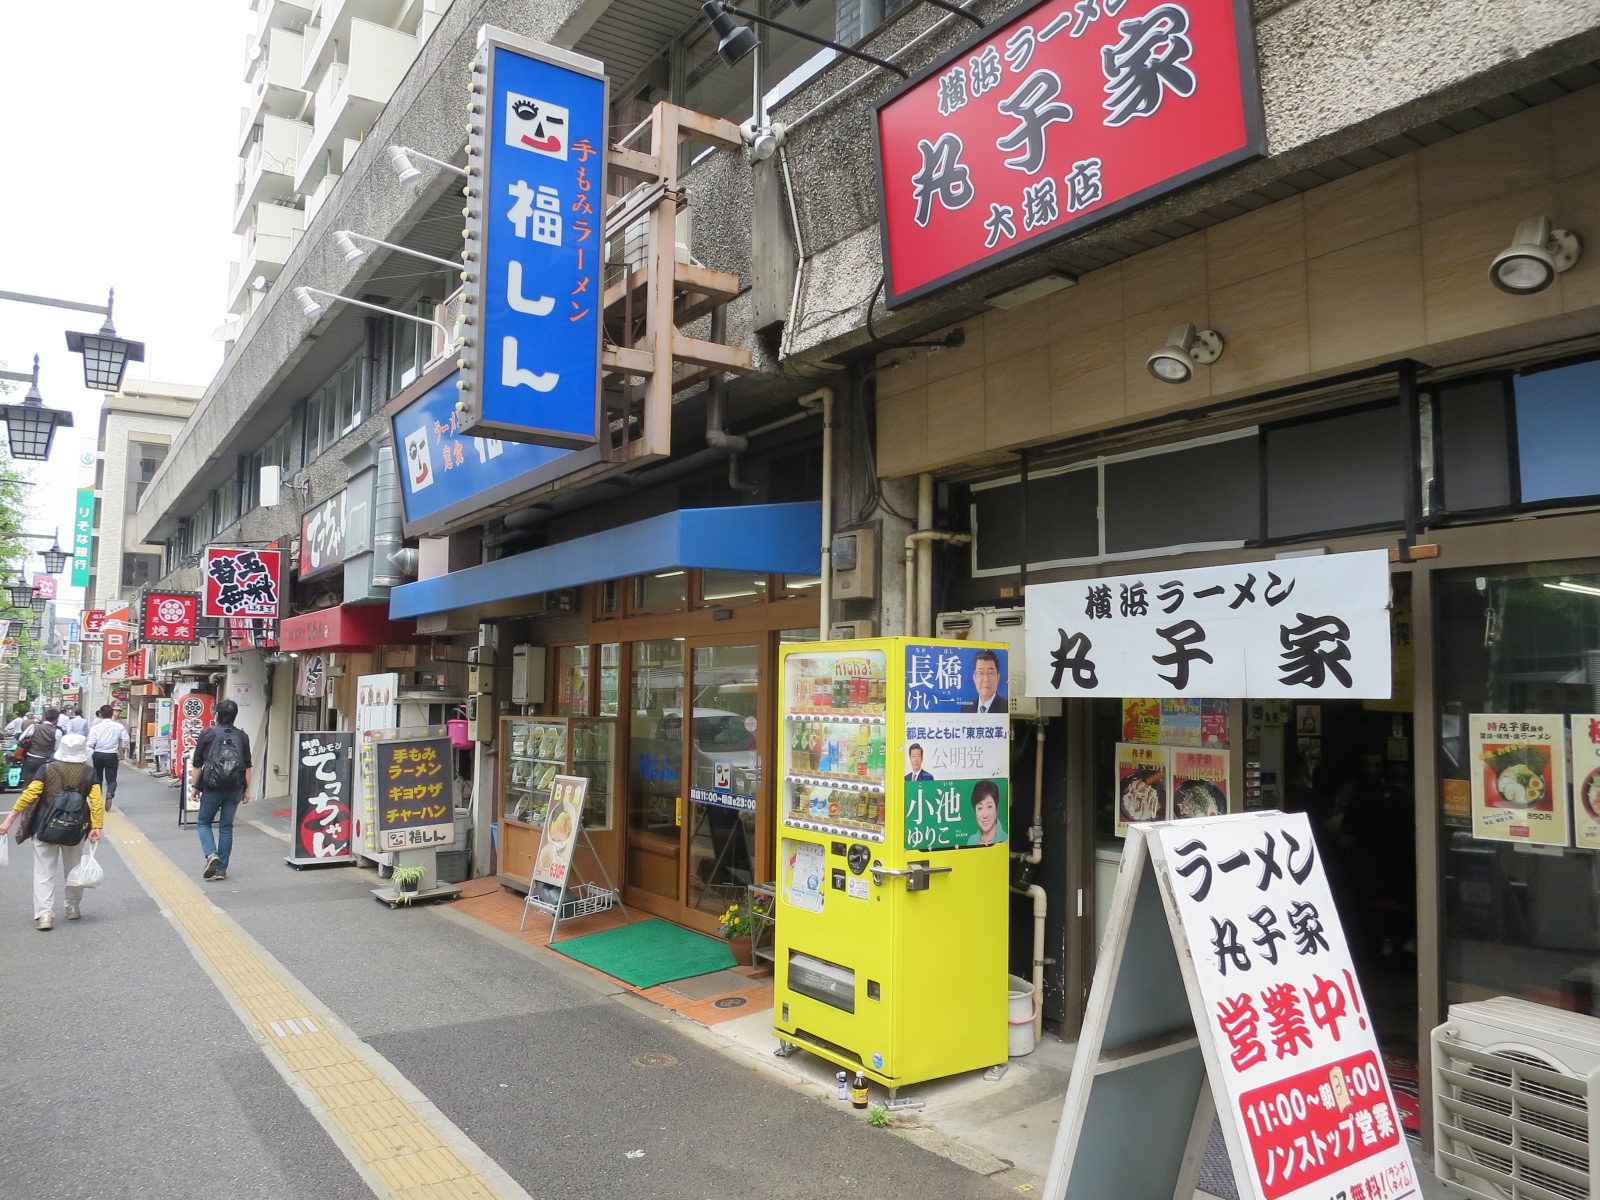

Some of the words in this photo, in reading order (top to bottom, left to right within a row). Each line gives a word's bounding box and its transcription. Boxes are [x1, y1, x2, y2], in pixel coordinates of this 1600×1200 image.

[912, 3, 1197, 227] 丸子家
[984, 157, 1102, 248] 大塚店
[569, 138, 597, 322] 手もみラーメン
[502, 179, 562, 393] 福しん
[74, 507, 90, 571] りそな銀行
[1085, 571, 1295, 620] 横浜ラーメン
[151, 625, 190, 637] 焼売
[1050, 613, 1353, 690] 丸子家
[835, 658, 872, 676] Aloha!
[907, 654, 962, 690] 長橋
[907, 690, 955, 711] けい一
[906, 727, 1007, 740] 都民とともに「東京改革」
[308, 742, 342, 756] ホルモン
[393, 747, 436, 763] 手もみ
[932, 745, 984, 769] 公明党
[389, 763, 442, 780] ラーメン
[302, 752, 347, 858] てっちゃん
[389, 783, 443, 801] ギョウザ
[906, 787, 962, 825] 小池
[386, 804, 446, 824] チャーハン
[1527, 813, 1552, 821] 850円
[409, 830, 446, 844] 福しん
[908, 826, 950, 848] ゆりこ
[1174, 829, 1315, 902] ラーメン
[1209, 900, 1330, 976] 丸子家
[1265, 1102, 1396, 1187] ノンストップ営業
